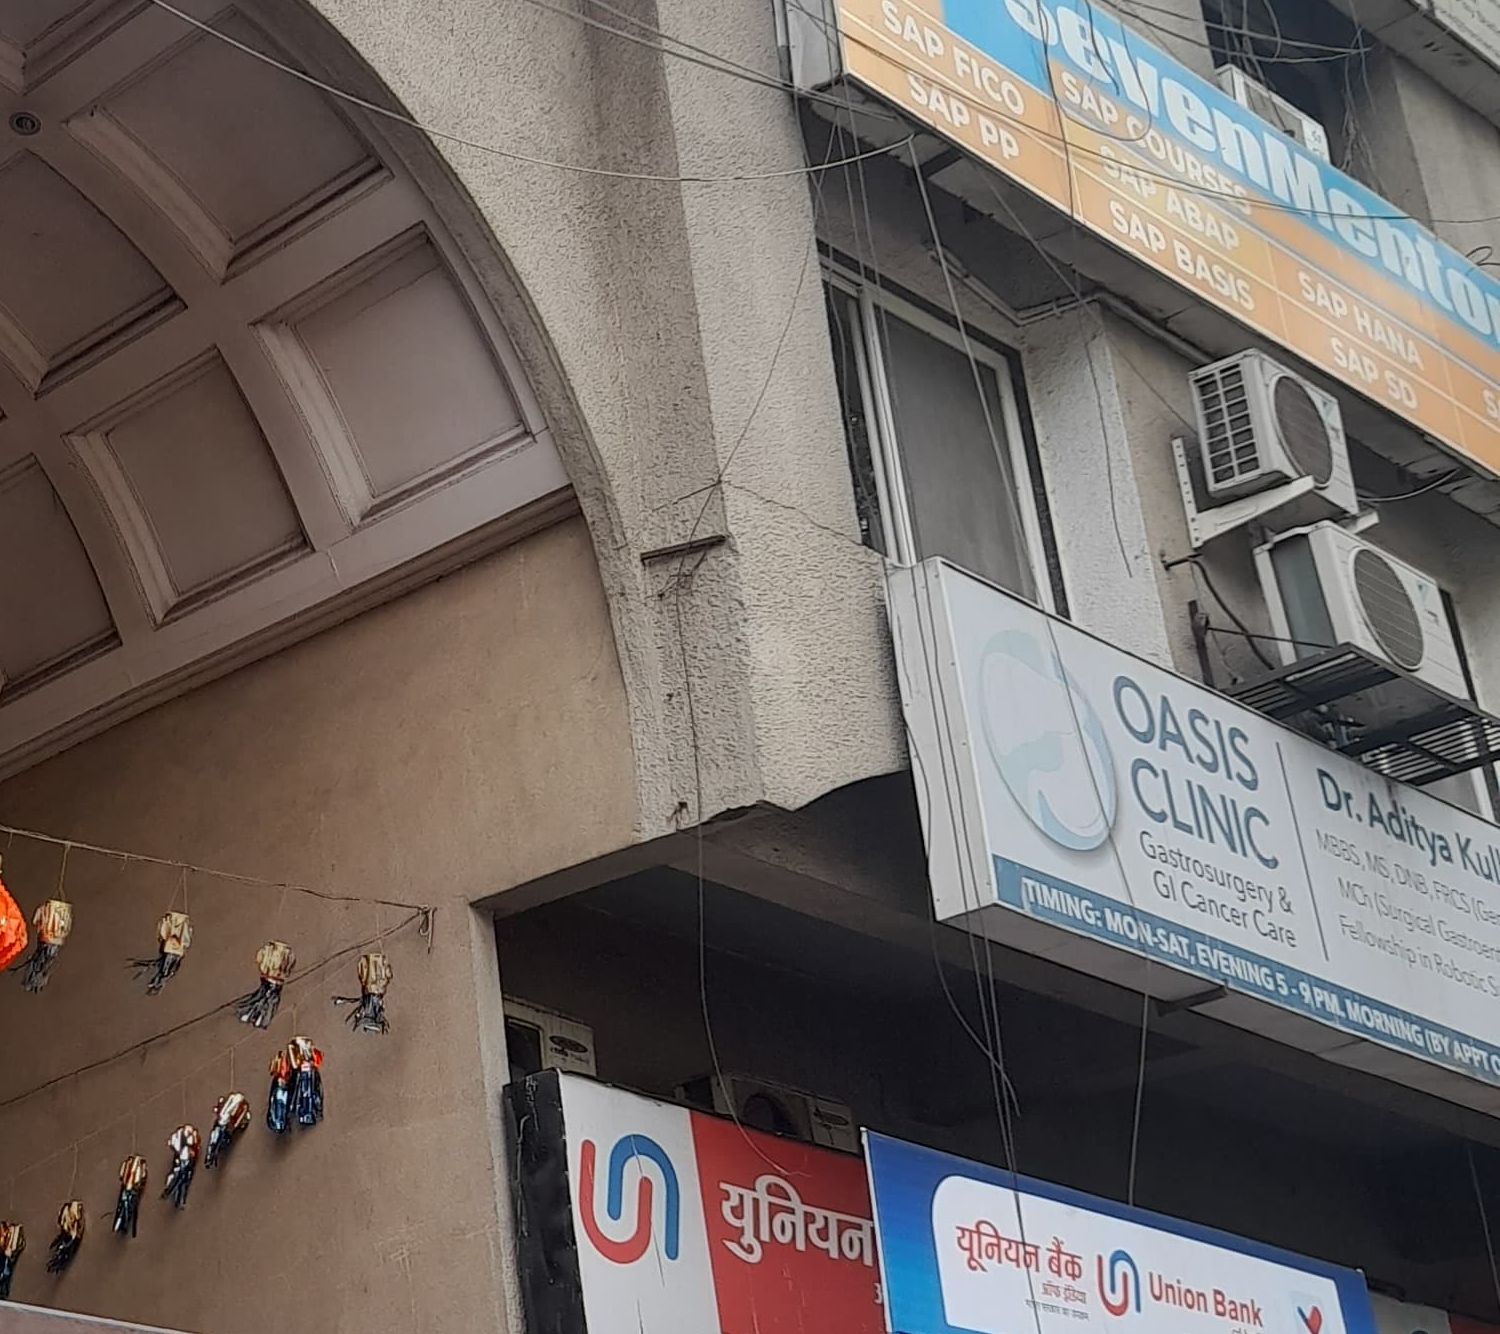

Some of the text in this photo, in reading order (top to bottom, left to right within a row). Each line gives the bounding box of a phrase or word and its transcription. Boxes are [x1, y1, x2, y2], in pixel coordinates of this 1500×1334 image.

[879, 0, 1026, 116] SAP FICO
[907, 73, 1020, 160] SAP PP
[1061, 70, 1252, 218] SAP COURSES
[1100, 143, 1241, 252] SAP ABAP
[1109, 199, 1255, 312] SAP BASIS
[1298, 271, 1425, 372] SAP HANA
[1331, 336, 1418, 409] SAP SD
[1113, 675, 1259, 792] OASIS
[1131, 758, 1280, 870] CLINIC
[1317, 768, 1454, 867] Dr. Aditya
[1139, 830, 1294, 915] Gastrosurgery &
[1153, 870, 1297, 948] GI Cancer Care
[1316, 829, 1366, 872] MBBS,
[1432, 881, 1471, 914] FRCS
[1374, 891, 1437, 937] (Surgical
[1022, 876, 1103, 928] TIMING:
[1103, 907, 1197, 965] MON-SAT,
[1196, 941, 1273, 991] EVENING
[1274, 971, 1290, 996] 5
[1346, 998, 1425, 1046] MORNING
[1424, 1028, 1451, 1057] (BY
[1451, 1041, 1488, 1069] APPT
[1340, 914, 1417, 969] Fellowship
[1434, 952, 1487, 986] Robotic
[955, 1219, 1083, 1281] यूनियन बैंक
[1148, 1271, 1264, 1328] Union Bank
